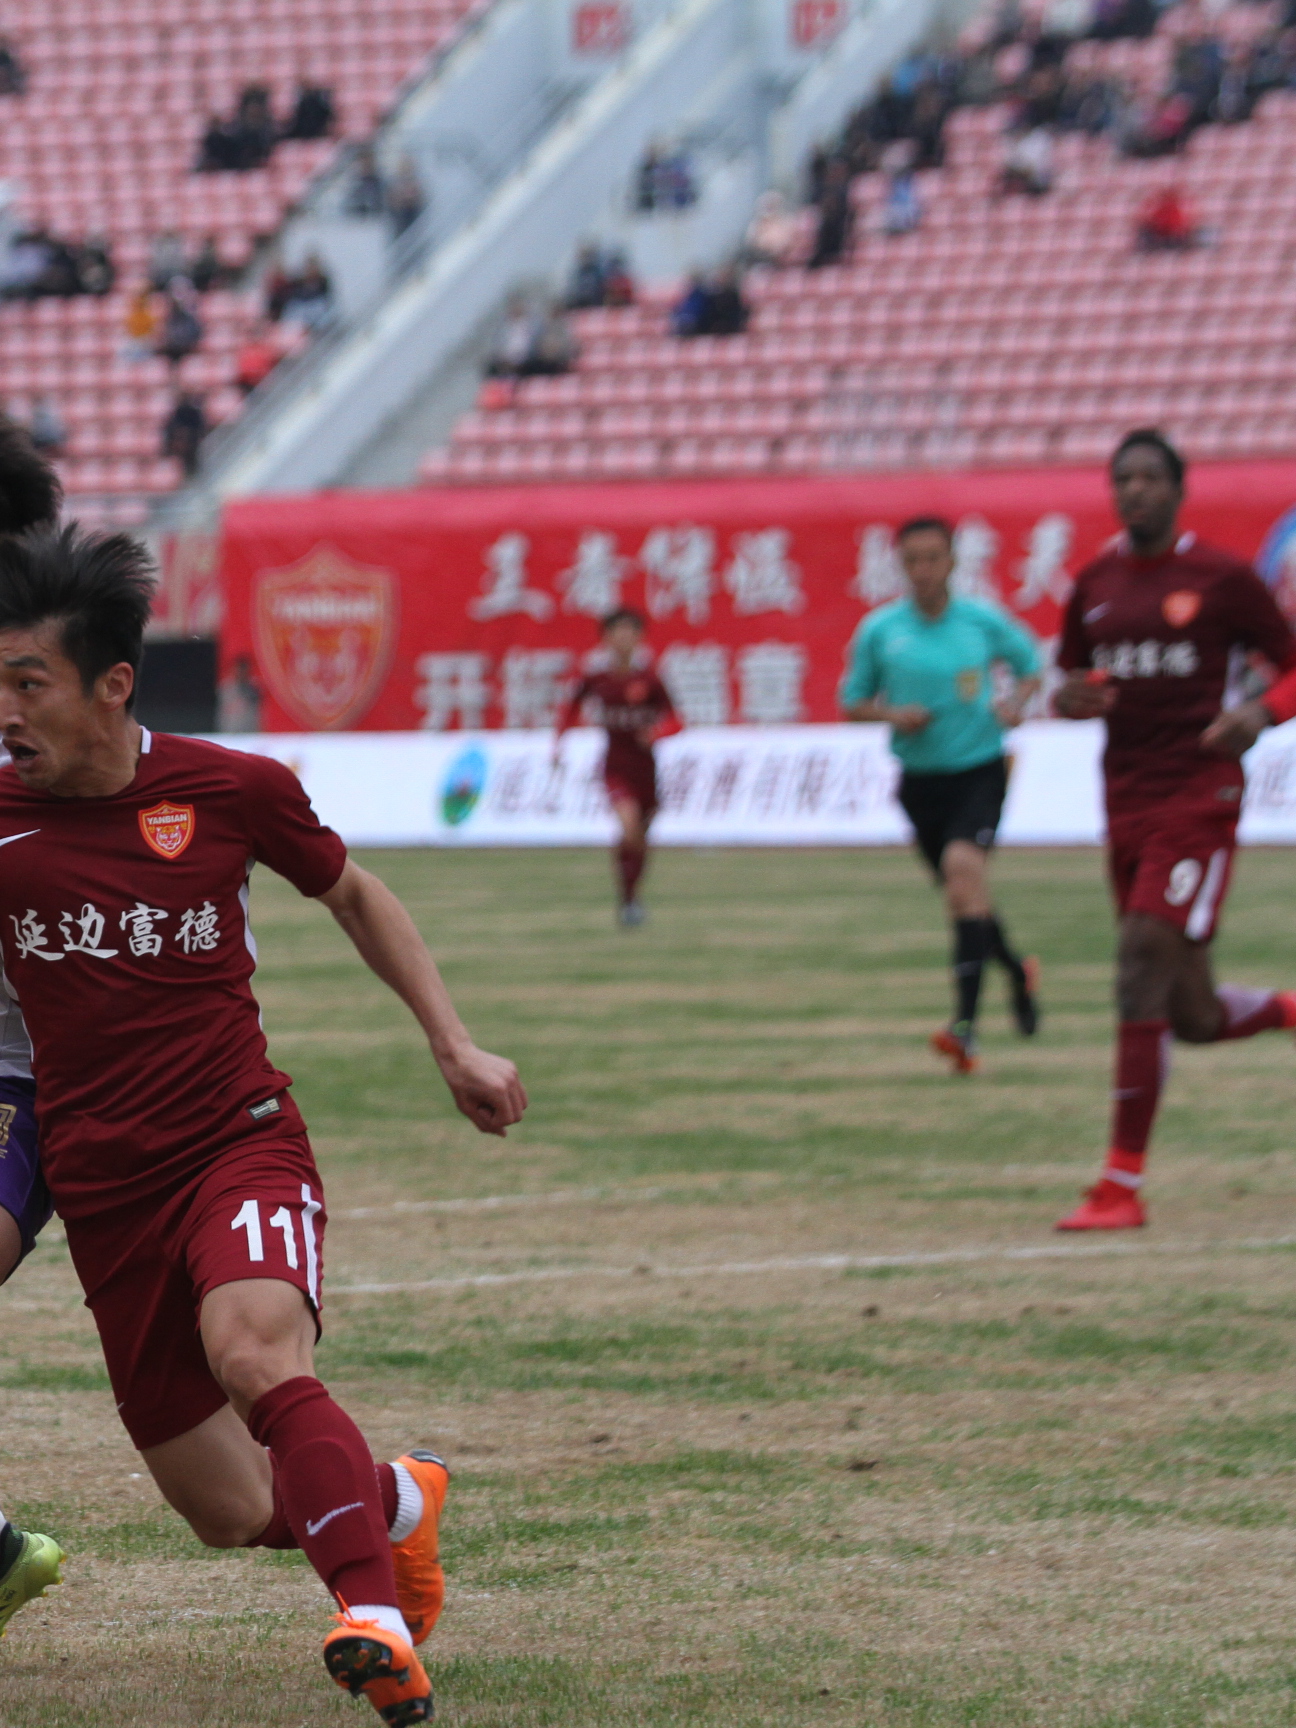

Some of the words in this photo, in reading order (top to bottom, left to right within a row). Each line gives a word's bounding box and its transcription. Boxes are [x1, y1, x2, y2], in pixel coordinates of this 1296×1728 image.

[146, 813, 187, 825] YANBIAN
[1164, 857, 1203, 907] 9
[8, 901, 220, 961] 延边富德
[231, 1199, 298, 1270] 11
